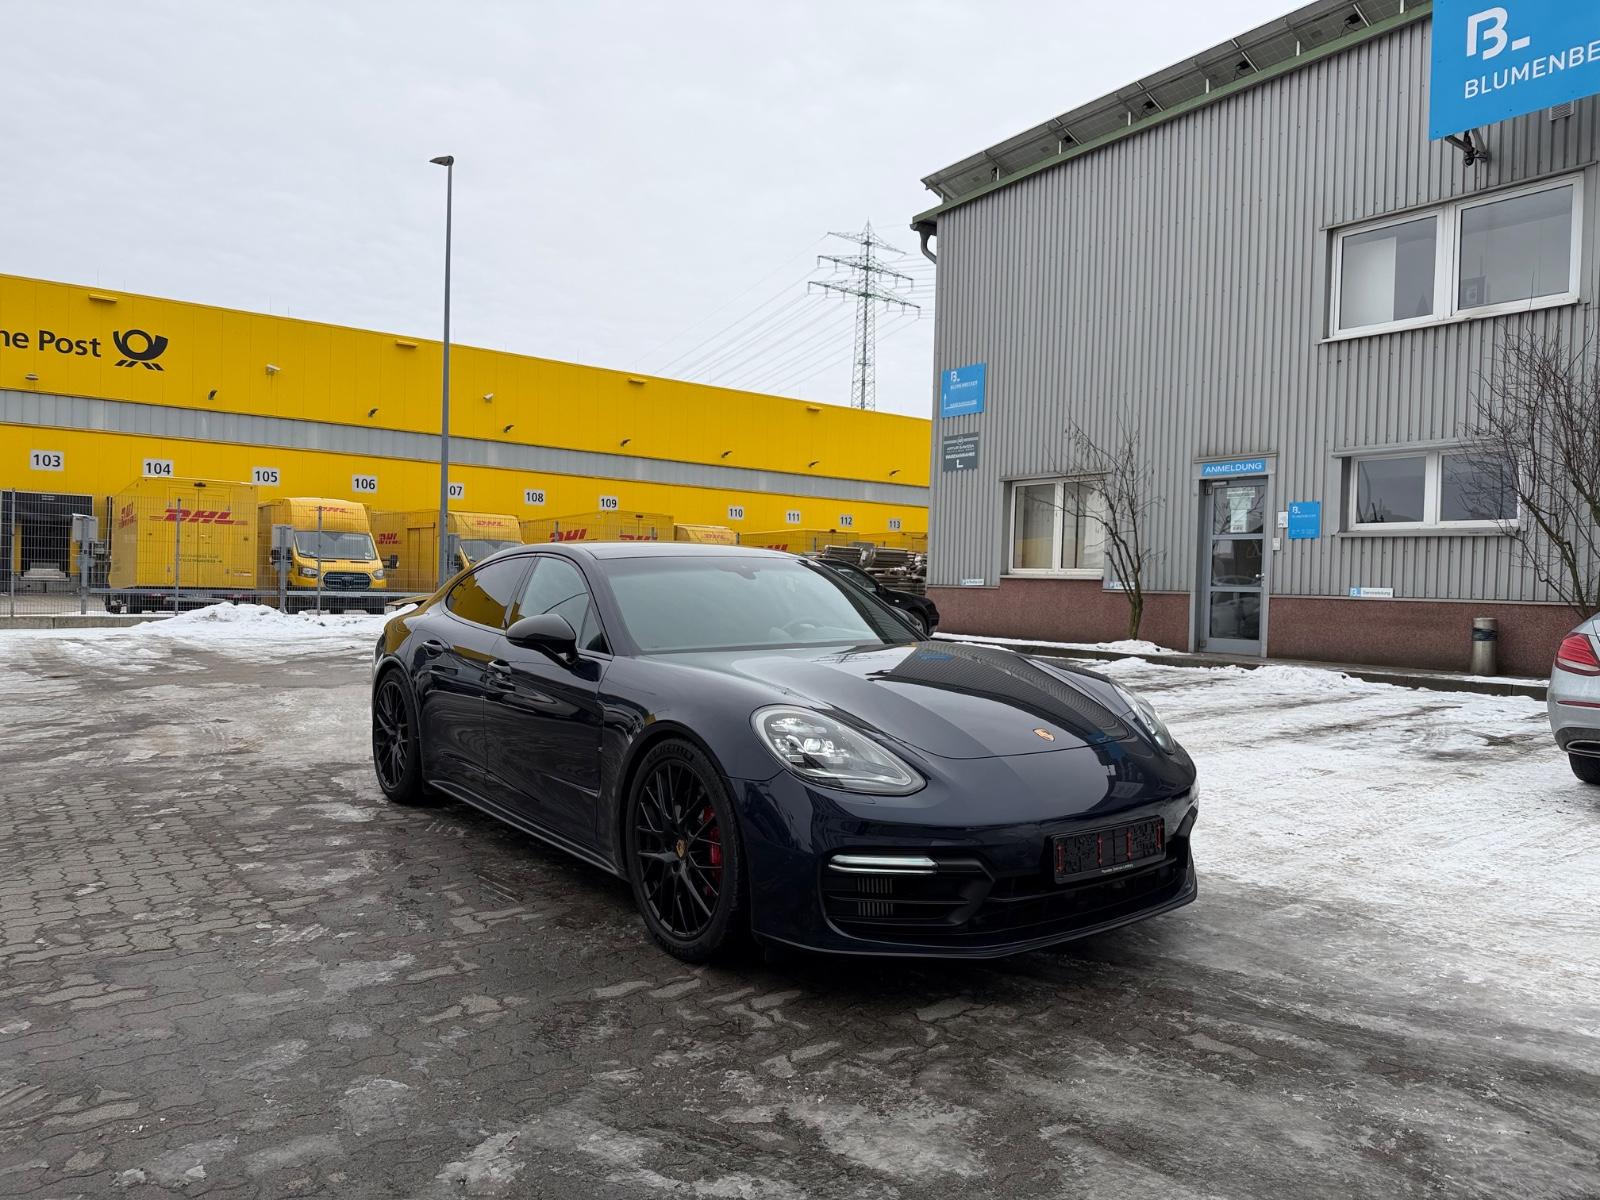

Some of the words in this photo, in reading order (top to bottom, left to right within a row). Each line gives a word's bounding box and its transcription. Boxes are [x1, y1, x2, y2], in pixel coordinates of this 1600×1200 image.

[1464, 40, 1600, 99] BLUMENBE
[39, 329, 101, 358] Post
[33, 454, 61, 467] 103
[146, 462, 171, 475] 104
[1205, 462, 1262, 473] ANMELDUNG
[255, 470, 278, 483] 105
[354, 478, 376, 490] 106
[449, 485, 463, 496] 07
[526, 491, 544, 502] 108
[600, 498, 617, 508] 109
[164, 508, 235, 526] DHL
[729, 508, 743, 518] 110
[788, 512, 800, 521] 111
[840, 516, 852, 525] 112
[889, 520, 900, 529] 113
